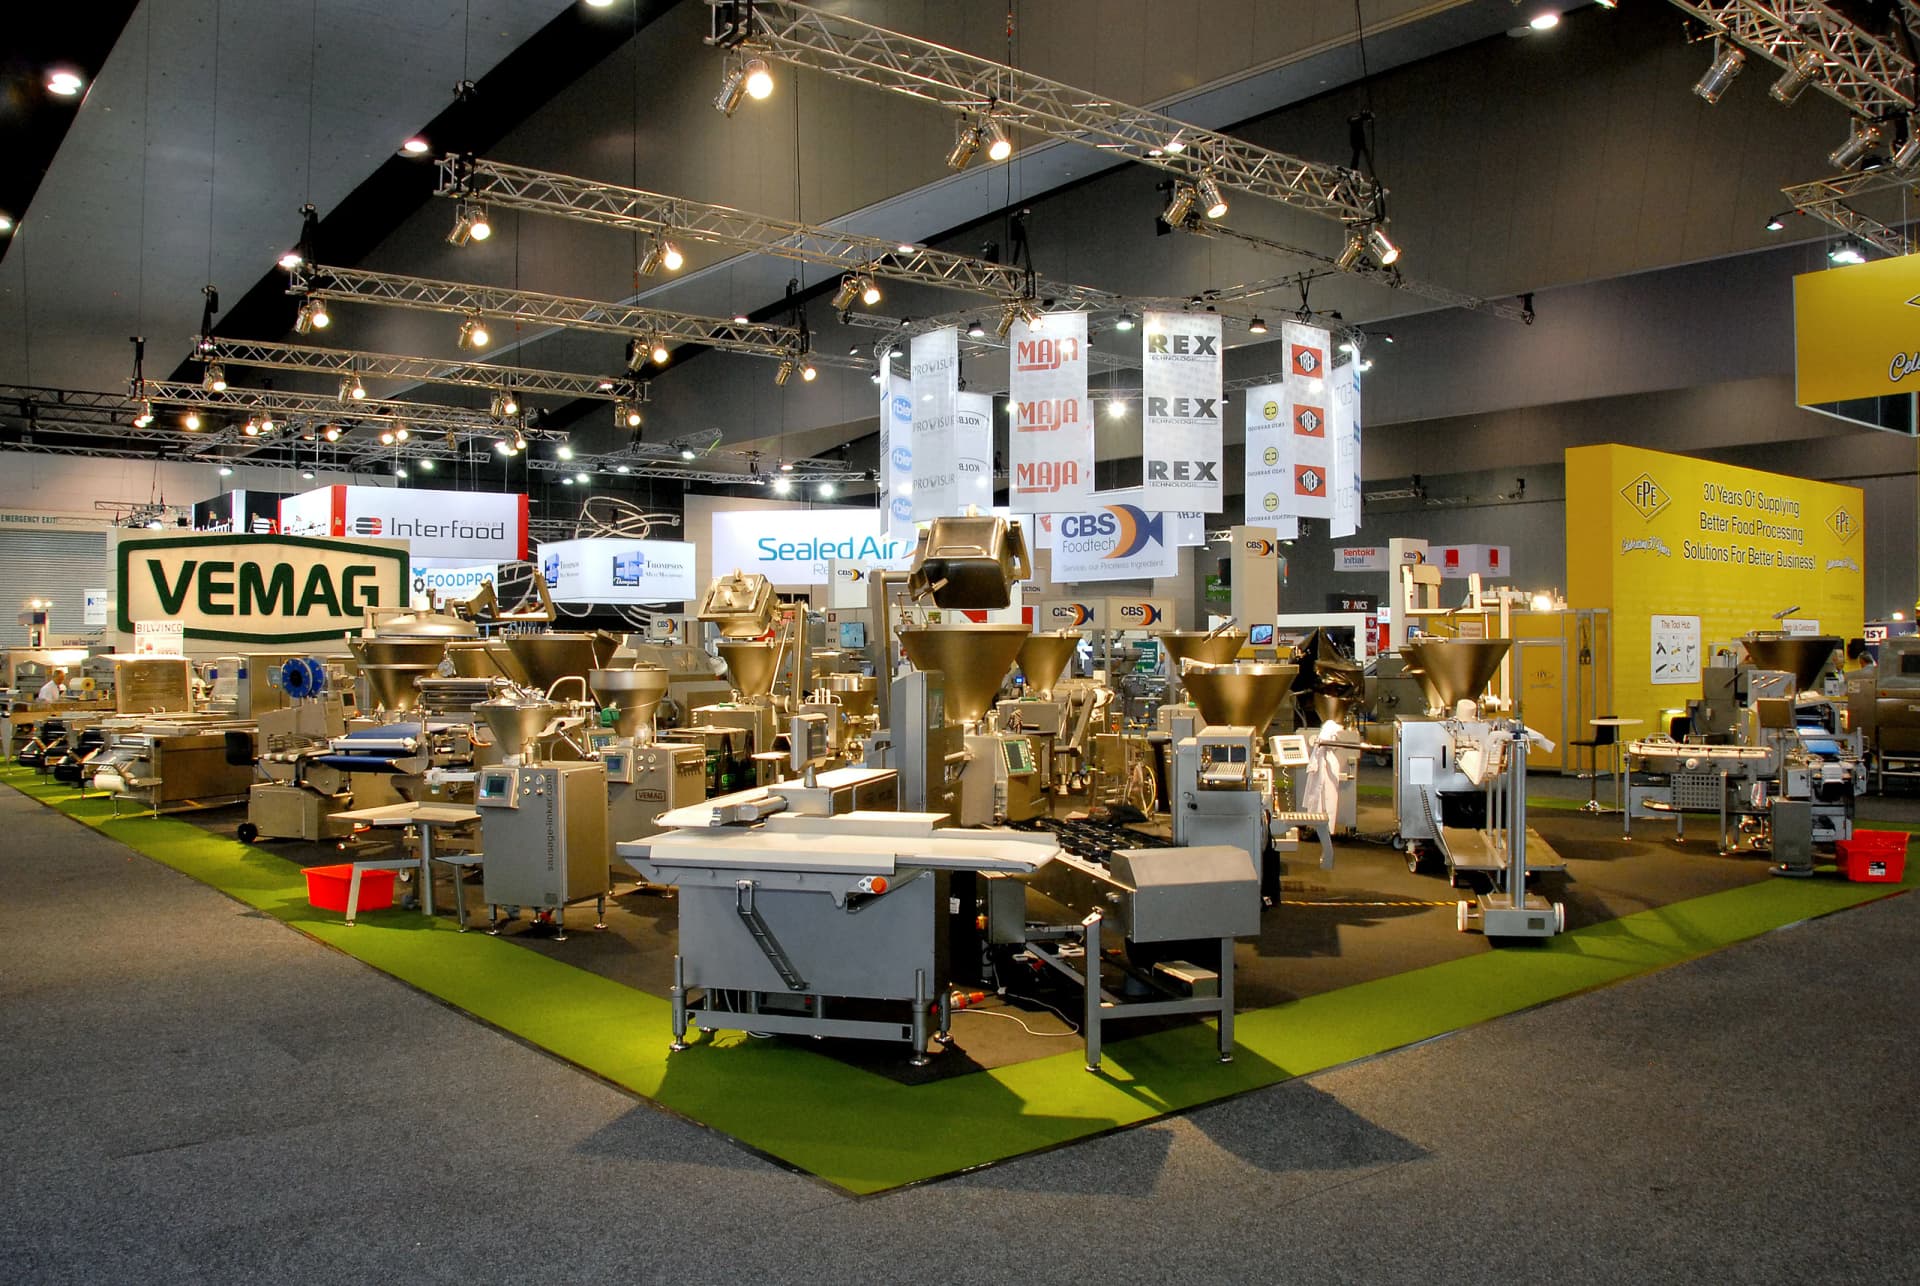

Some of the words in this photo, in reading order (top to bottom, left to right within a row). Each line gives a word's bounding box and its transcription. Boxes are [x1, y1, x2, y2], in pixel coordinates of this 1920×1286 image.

[1017, 337, 1078, 371] MAJA
[1148, 334, 1217, 355] REX
[1889, 352, 1920, 382] Cel
[1017, 399, 1078, 432] MAJA
[1148, 397, 1217, 418] REX
[1017, 460, 1078, 493] MAJA
[1148, 460, 1217, 482] REX
[1636, 480, 1657, 508] FPE
[1703, 483, 1715, 502] 30
[1717, 485, 1743, 506] Years
[1744, 489, 1756, 507] Of
[1757, 491, 1800, 518] Supplying
[0, 514, 40, 523] EMERGENCY
[42, 516, 56, 524] EXIT
[391, 517, 504, 540] Interfood
[1061, 512, 1116, 538] CBS
[1700, 511, 1729, 532] Better
[1731, 516, 1755, 536] Food
[1757, 520, 1804, 545] Processing
[1835, 511, 1849, 533] FPE
[758, 536, 853, 561] Sealed
[857, 536, 898, 560] Air
[1062, 537, 1116, 553] Foodtech
[1246, 541, 1262, 549] CBS
[1343, 549, 1376, 557] Rentokil
[1404, 551, 1416, 559] CBS
[1684, 540, 1729, 562] Solutions
[1731, 545, 1746, 563] For
[1748, 547, 1774, 566] Better
[1777, 550, 1816, 570] Business!
[1130, 559, 1164, 569] Ingredient
[146, 559, 379, 617] VEMAG
[426, 572, 494, 587] FOODPRO
[1053, 606, 1075, 617] CBS
[1120, 606, 1144, 617] CBS
[136, 623, 183, 633] BILWINCO
[1661, 620, 1671, 629] The
[1672, 620, 1681, 629] Tool
[62, 638, 101, 646] weber
[638, 791, 663, 800] VEMAG
